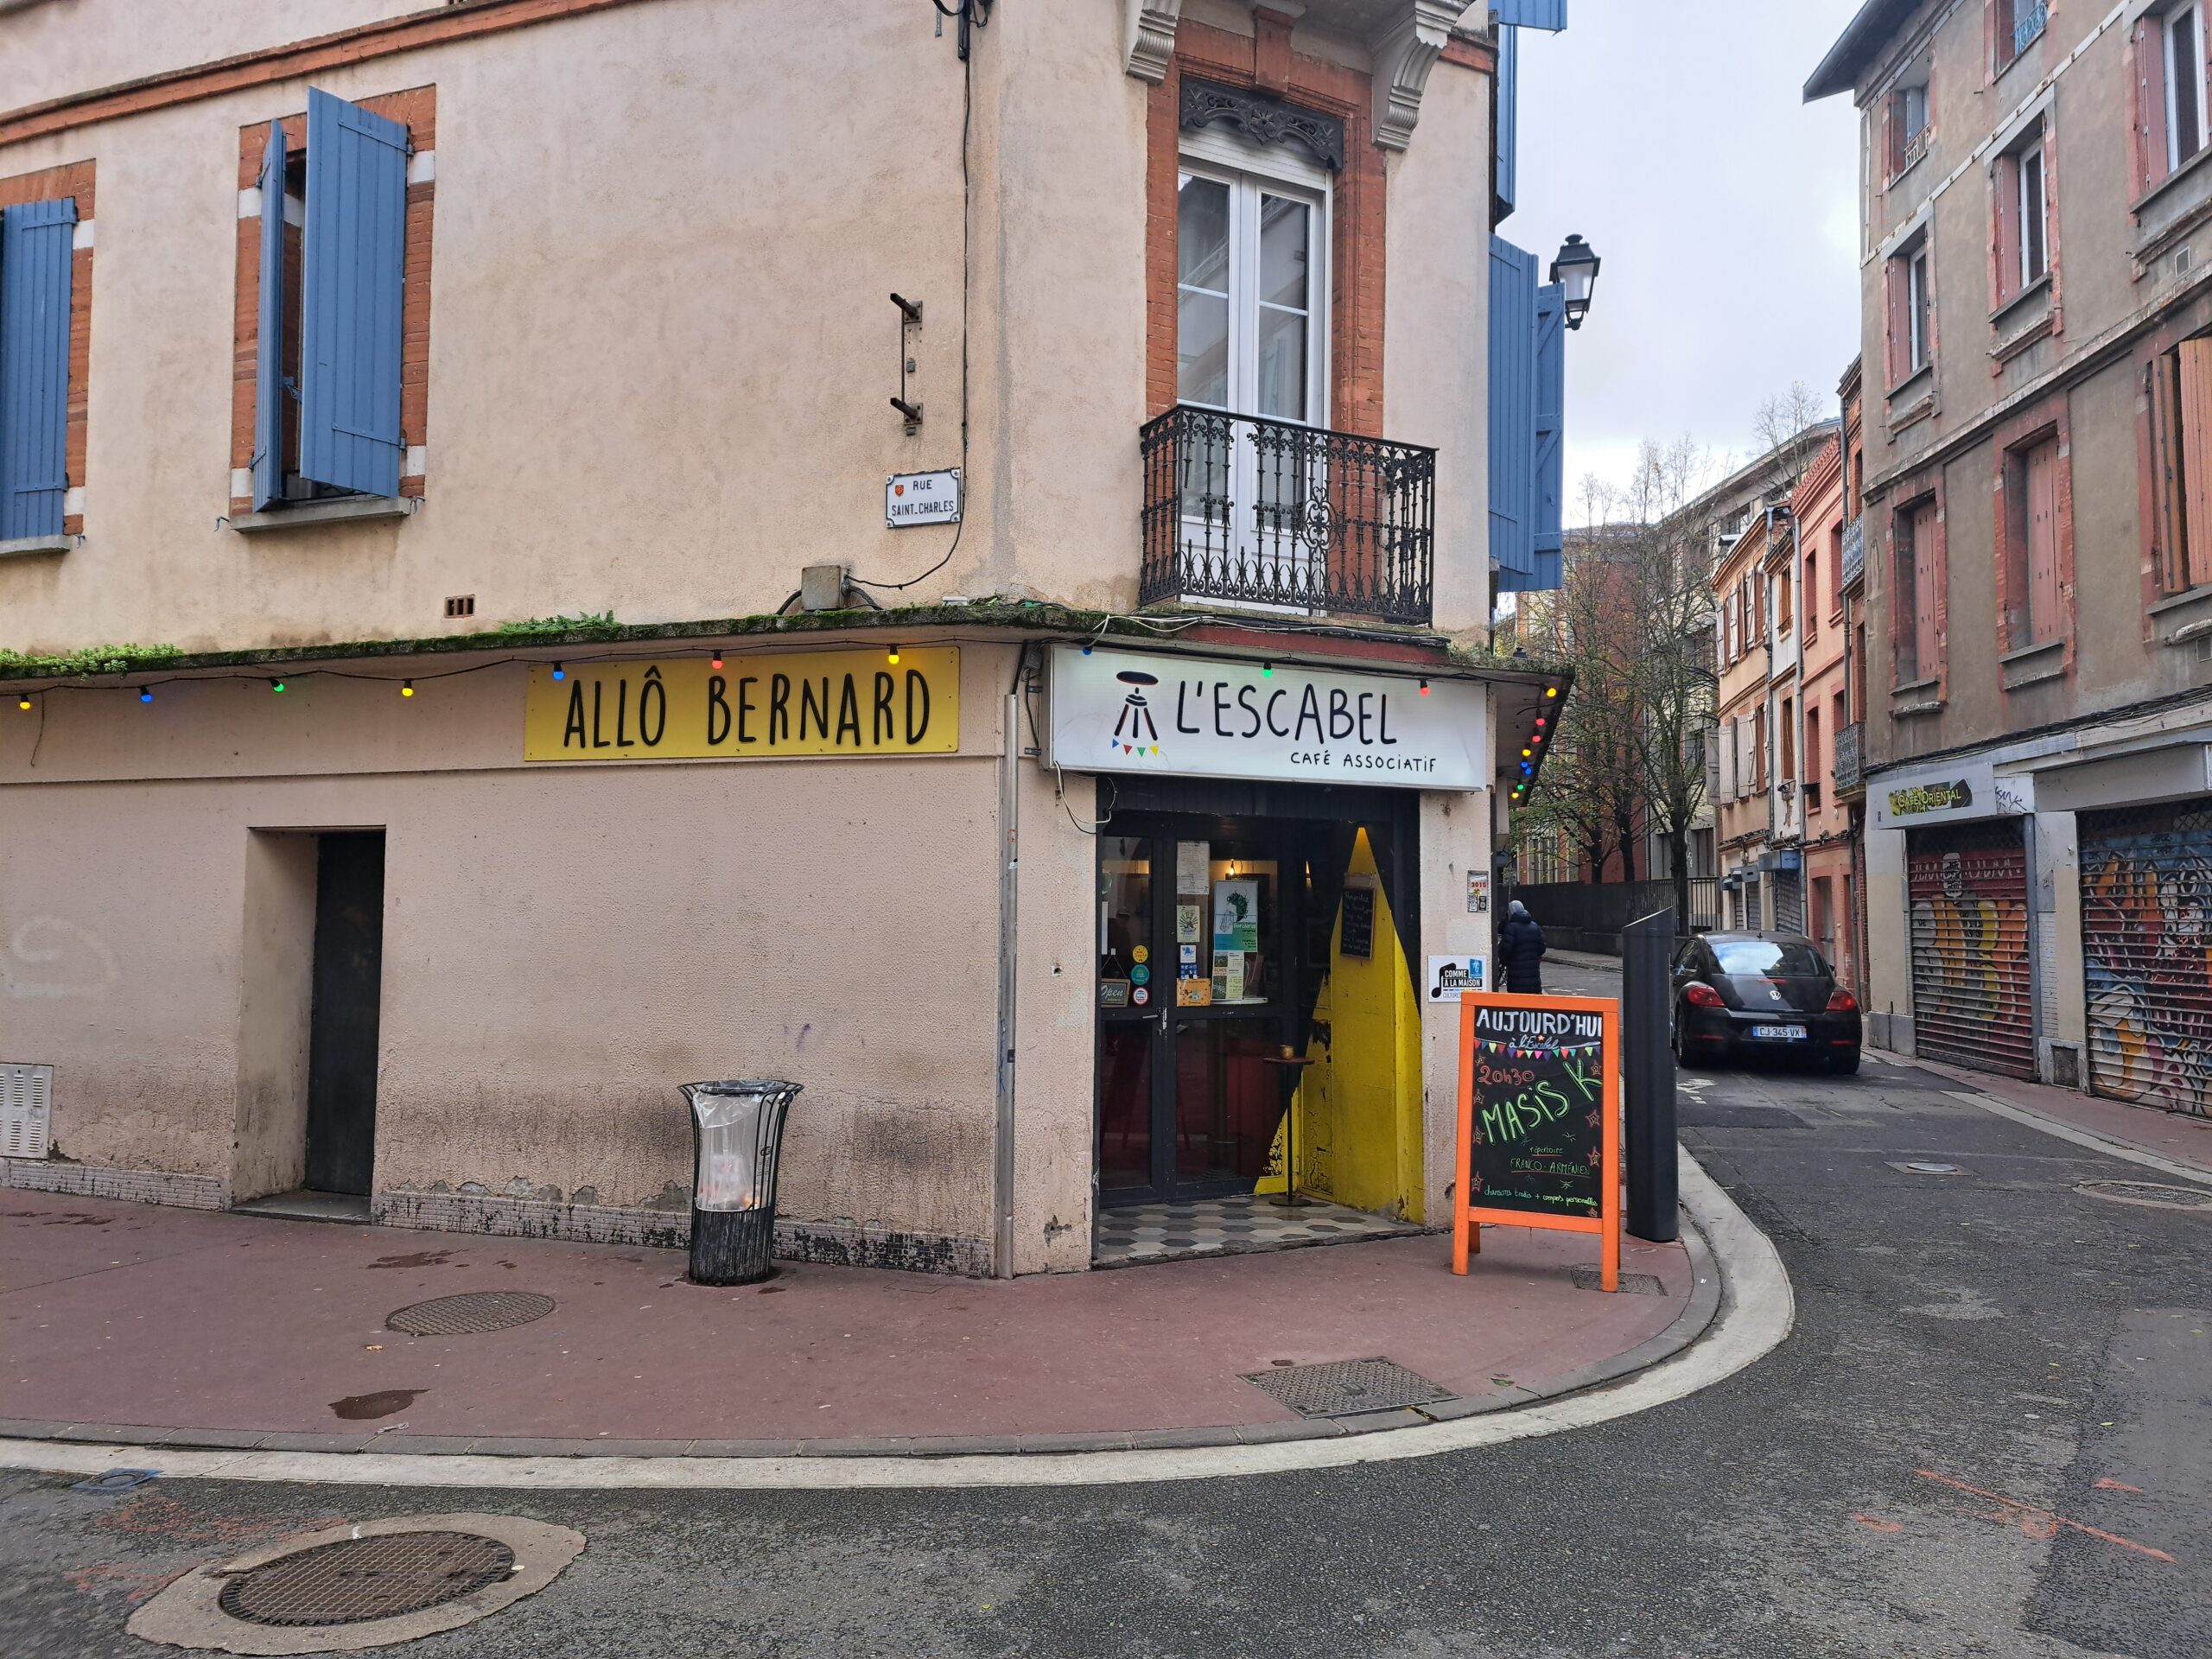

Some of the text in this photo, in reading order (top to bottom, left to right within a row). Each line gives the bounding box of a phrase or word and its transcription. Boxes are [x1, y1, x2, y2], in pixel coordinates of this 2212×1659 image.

[912, 479, 933, 491] RUE
[563, 664, 931, 749] ALLÔ BERNARD
[1176, 679, 1398, 746] L'ESCABEL
[1290, 749, 1331, 766] CAFÉ
[1921, 788, 1961, 804] ORIENTAL
[1445, 969, 1467, 978] COMME
[1476, 1008, 1602, 1038] AUJOURD'HUI
[1759, 1027, 1800, 1037] CJ-345-VX
[1509, 1037, 1517, 1049] à
[1478, 1065, 1535, 1085] 20h30
[1510, 1158, 1541, 1172] FRANCO
